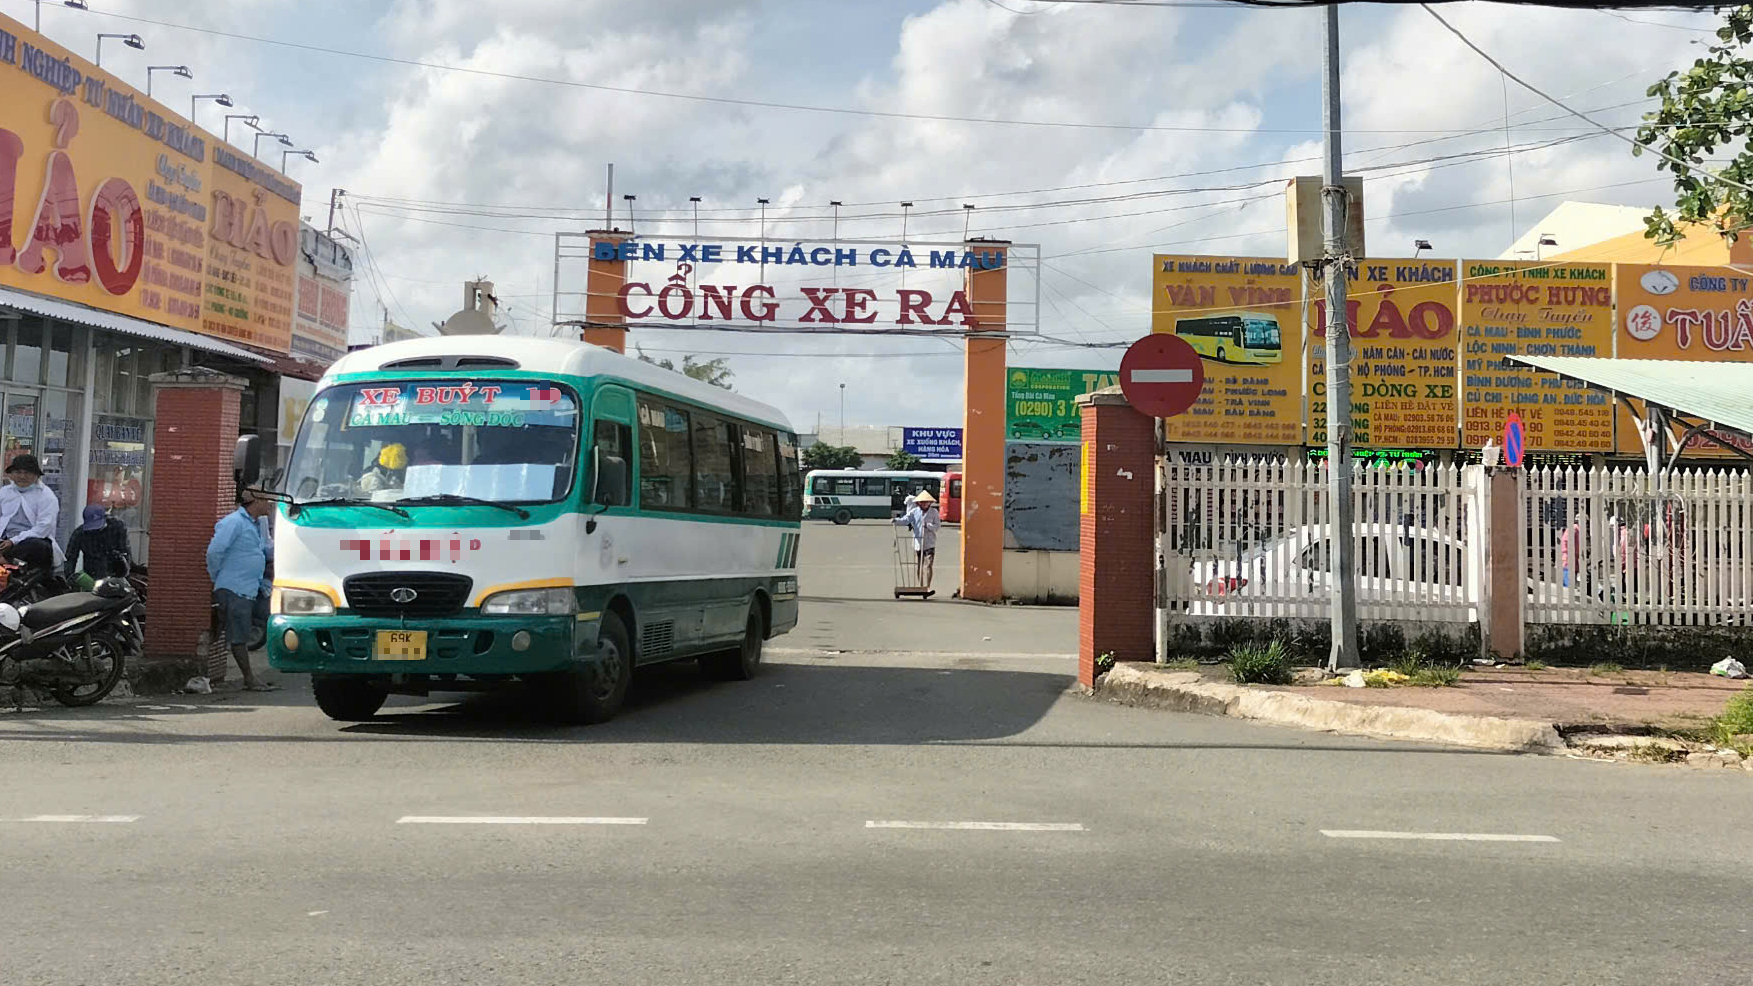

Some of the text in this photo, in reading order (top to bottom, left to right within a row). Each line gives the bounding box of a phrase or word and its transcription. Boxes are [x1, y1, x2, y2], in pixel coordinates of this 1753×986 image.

[678, 243, 723, 263] XE
[737, 241, 857, 267] KHÁCH
[869, 244, 917, 268] CÀ
[930, 250, 1004, 270] MAU
[1367, 266, 1388, 282] XE
[1396, 263, 1453, 282] KHÁCH
[1470, 264, 1606, 280] CÔNG TY TNHH XE KHÁCH
[1690, 273, 1749, 293] CÔNG TY
[617, 263, 980, 327] CỔNG XE RA
[1466, 279, 1611, 307] PHƯỚC HƯNG
[1484, 326, 1508, 338] MAU
[1491, 343, 1516, 354] NINH
[359, 387, 402, 406] XE
[1362, 378, 1418, 398] DÒNG
[1425, 384, 1454, 399] XE
[1484, 391, 1502, 403] CHI
[1511, 392, 1539, 404] LONG
[1015, 400, 1053, 417] (0290)
[1057, 400, 1066, 416] 3
[351, 409, 373, 426] CÀ
[377, 411, 412, 426] MAU
[439, 409, 485, 427] SÔNG
[912, 430, 934, 438] KHU
[1530, 422, 1543, 433] 90
[1312, 432, 1327, 443] 40
[1530, 435, 1543, 447] 70
[390, 632, 411, 643] 69K
